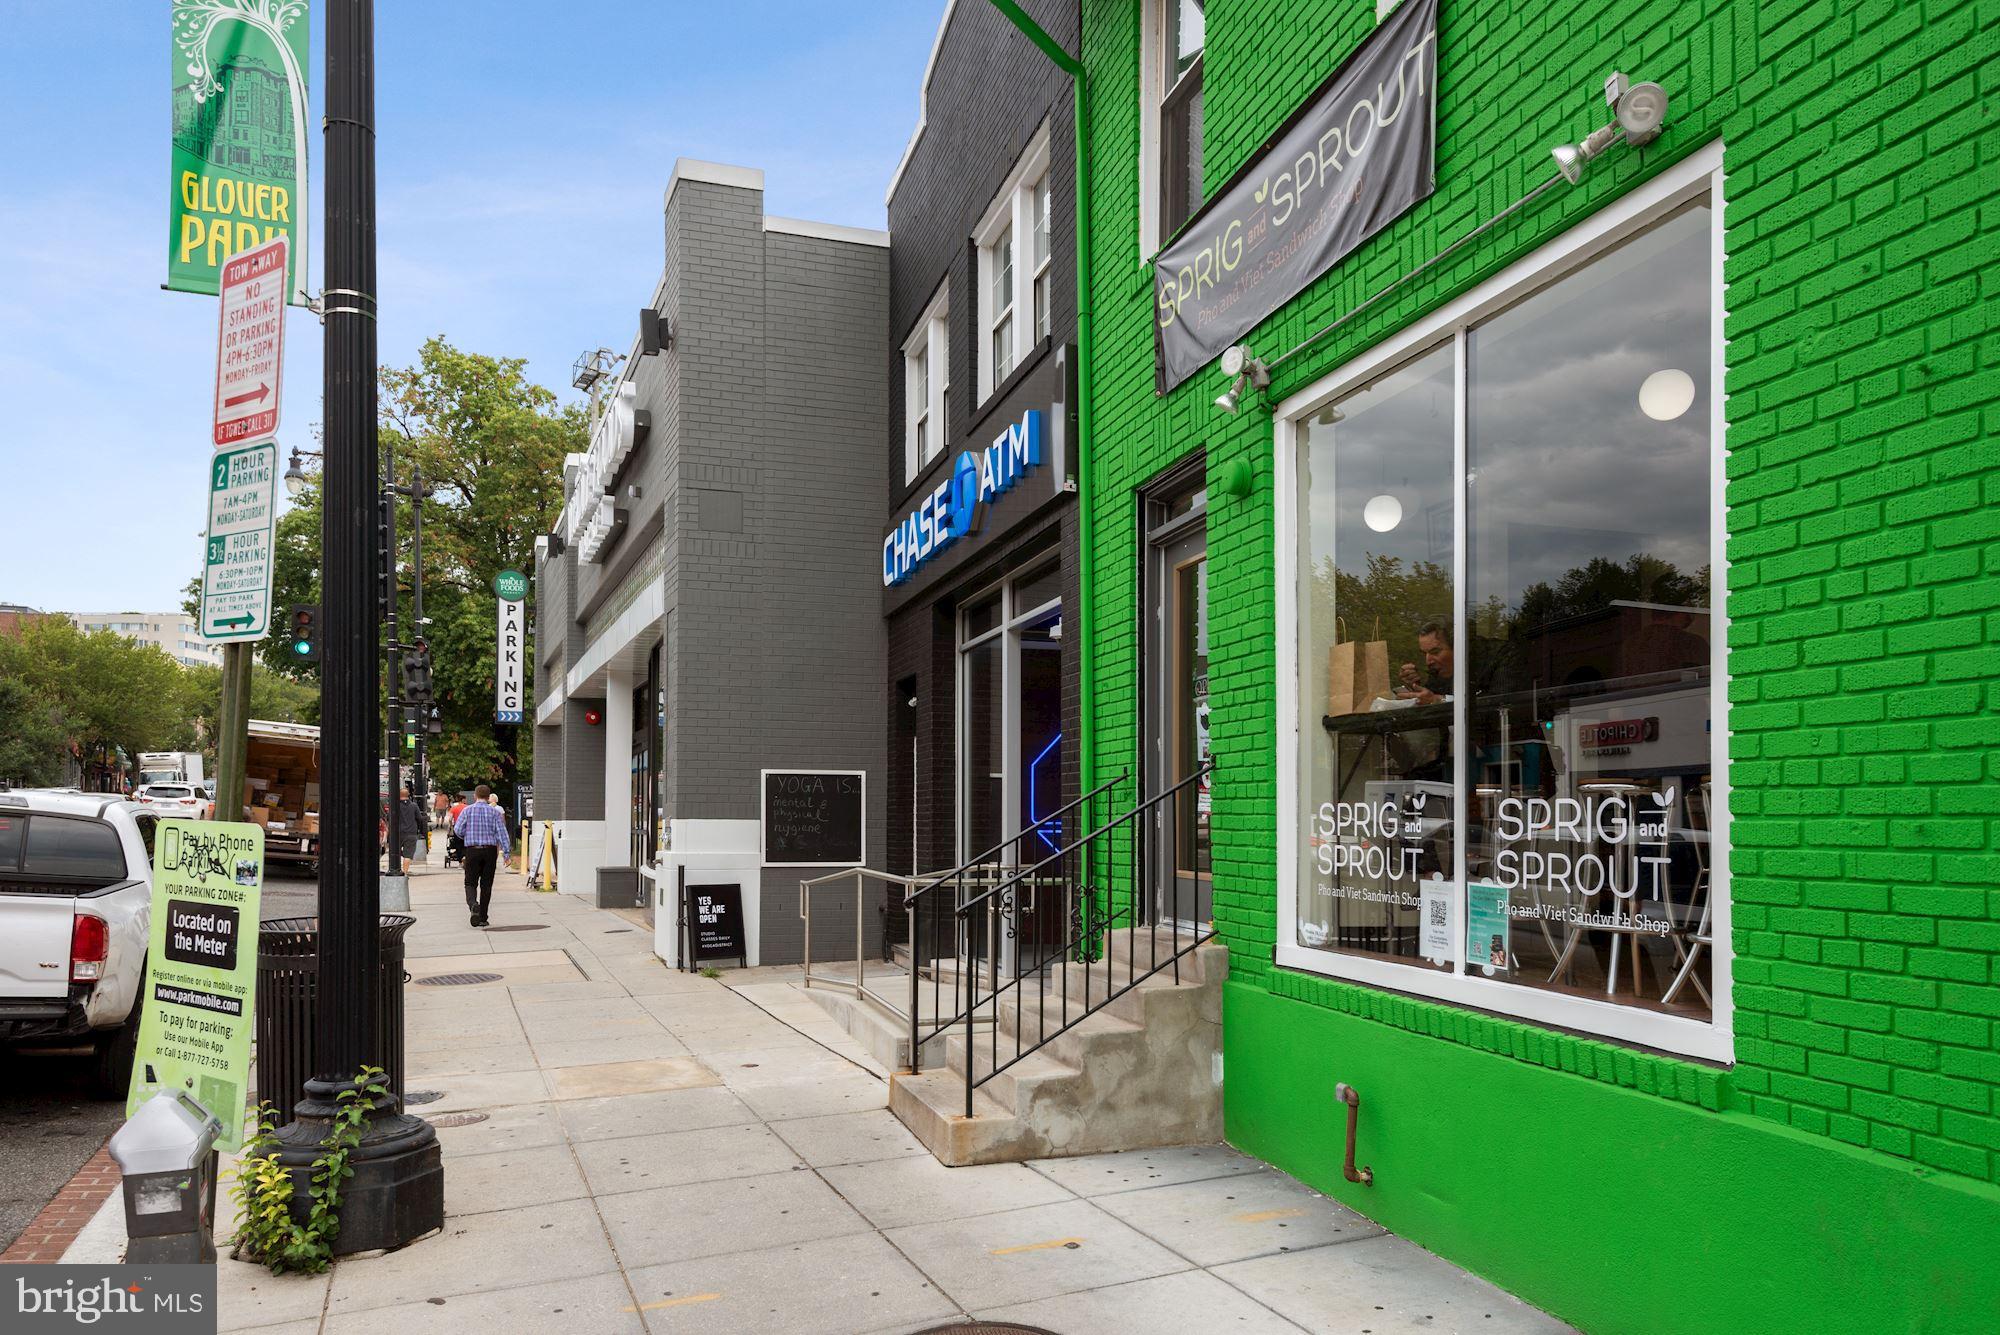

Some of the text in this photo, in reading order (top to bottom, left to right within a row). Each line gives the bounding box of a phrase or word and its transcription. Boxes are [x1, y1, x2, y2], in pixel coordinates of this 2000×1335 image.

[1158, 29, 1436, 328] SPRIG and SPROUT
[181, 170, 290, 223] GLOVER
[229, 250, 278, 282] TOW AWAY
[1197, 308, 1218, 330] Pho
[1220, 288, 1240, 317] and
[1240, 264, 1264, 292] Viet
[1266, 208, 1327, 274] Sandwich
[245, 282, 261, 301] NO
[229, 296, 275, 327] STANDING
[225, 318, 276, 349] OR PARKING
[226, 339, 274, 367] 4PM-6:30PM
[225, 360, 272, 385] MONDAY-FRIDAY
[217, 412, 273, 440] IF TOWED CALL 311
[233, 452, 265, 472] HOUR
[216, 463, 226, 488] 2
[231, 466, 269, 489] PARKING
[223, 491, 258, 509] 7AM-4PM
[883, 409, 1036, 587] CHASE ATM
[216, 505, 266, 526] MONDAY-SATURDAY
[233, 533, 259, 549] HOUR
[227, 547, 266, 565] PARKING
[216, 576, 263, 591] MONDAY-SATURDAY
[218, 565, 263, 580] 6:30PM-10PM
[499, 577, 524, 586] WHOLE
[215, 593, 254, 604] PAY TO PARK
[228, 603, 244, 611] TIMES
[504, 604, 518, 708] PARKING
[777, 776, 825, 794] YOGA
[773, 797, 815, 808] mental
[773, 808, 830, 823] physical
[1319, 801, 1422, 839] SPRIG and
[1498, 796, 1668, 844] SPRIG and
[219, 833, 254, 852] Phone
[1318, 843, 1424, 882] SPROUT
[1496, 850, 1672, 901] SPROUT
[165, 883, 183, 896] YOUR
[184, 885, 216, 899] PARKING
[698, 896, 712, 905] YES
[1318, 883, 1421, 911] Pho and Viet Sandwich Shop
[172, 909, 232, 935] Located on
[699, 904, 726, 915] WE ARE
[699, 914, 717, 924] OPEN
[1496, 899, 1517, 916] Pho
[1519, 904, 1541, 919] and
[1542, 904, 1567, 922] Viet
[1569, 907, 1632, 928] Sandwich
[1634, 913, 1670, 938] Shop
[174, 931, 228, 957] the Meter
[152, 969, 176, 981] Register
[176, 974, 194, 985] online
[195, 978, 202, 986] or
[203, 978, 212, 988] via
[212, 979, 233, 992] mobile
[157, 986, 240, 1013] www.parkmobile.com
[160, 1010, 234, 1040] To pay for parking:
[164, 1030, 224, 1053] Use our Mobile App
[156, 1046, 229, 1071] or Call 1-877-727-5758
